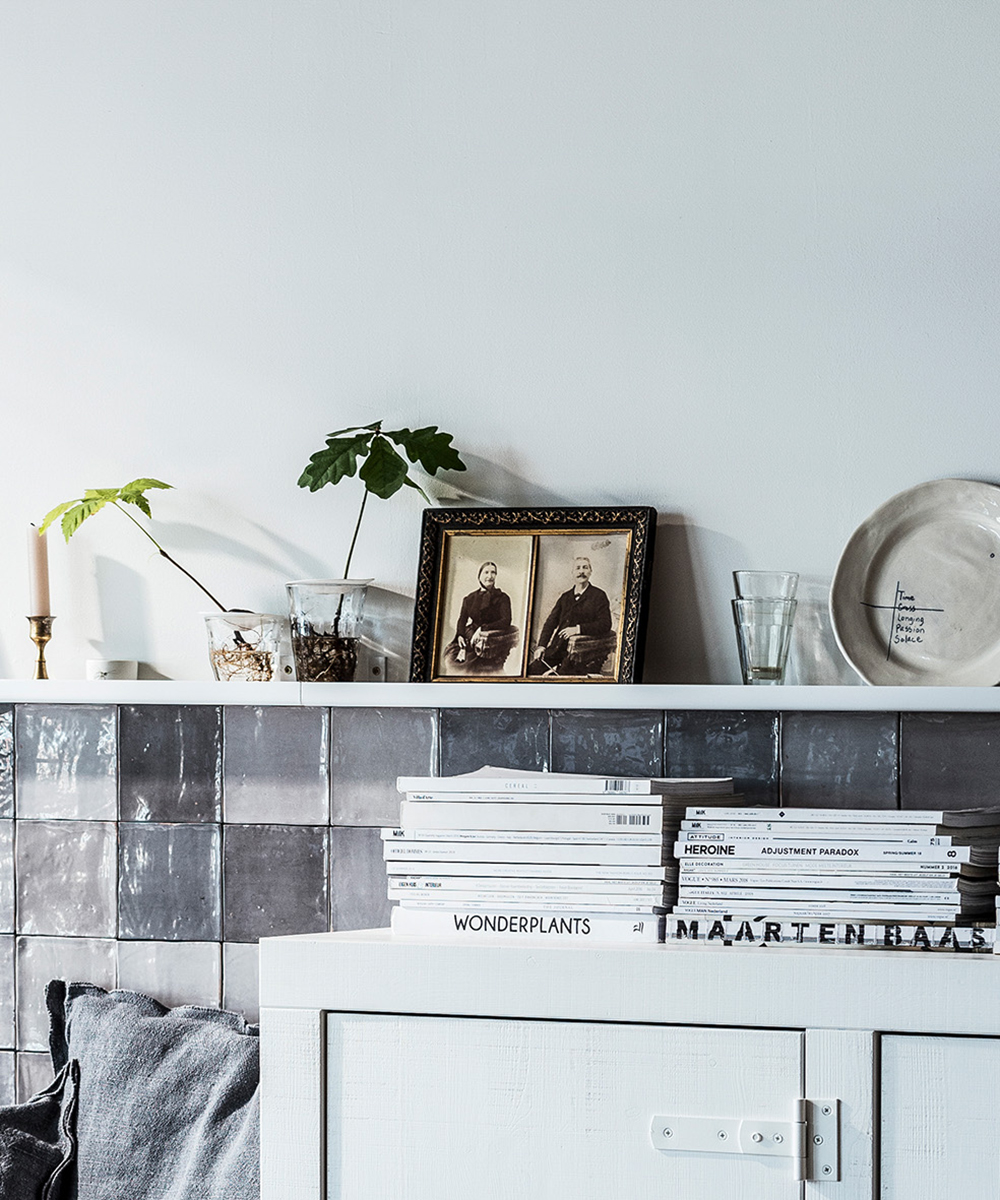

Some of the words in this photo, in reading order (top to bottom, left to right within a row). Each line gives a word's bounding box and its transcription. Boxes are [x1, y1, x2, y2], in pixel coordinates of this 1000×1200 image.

[896, 624, 926, 634] Passion
[894, 635, 924, 644] Solace
[684, 844, 735, 855] HEROINE
[761, 847, 817, 856] ADJUSTMENT
[819, 847, 860, 857] PARADOX
[454, 914, 591, 934] WONDERPLANTS
[676, 919, 863, 943] MAARTEN
[884, 926, 985, 947] BAAS
